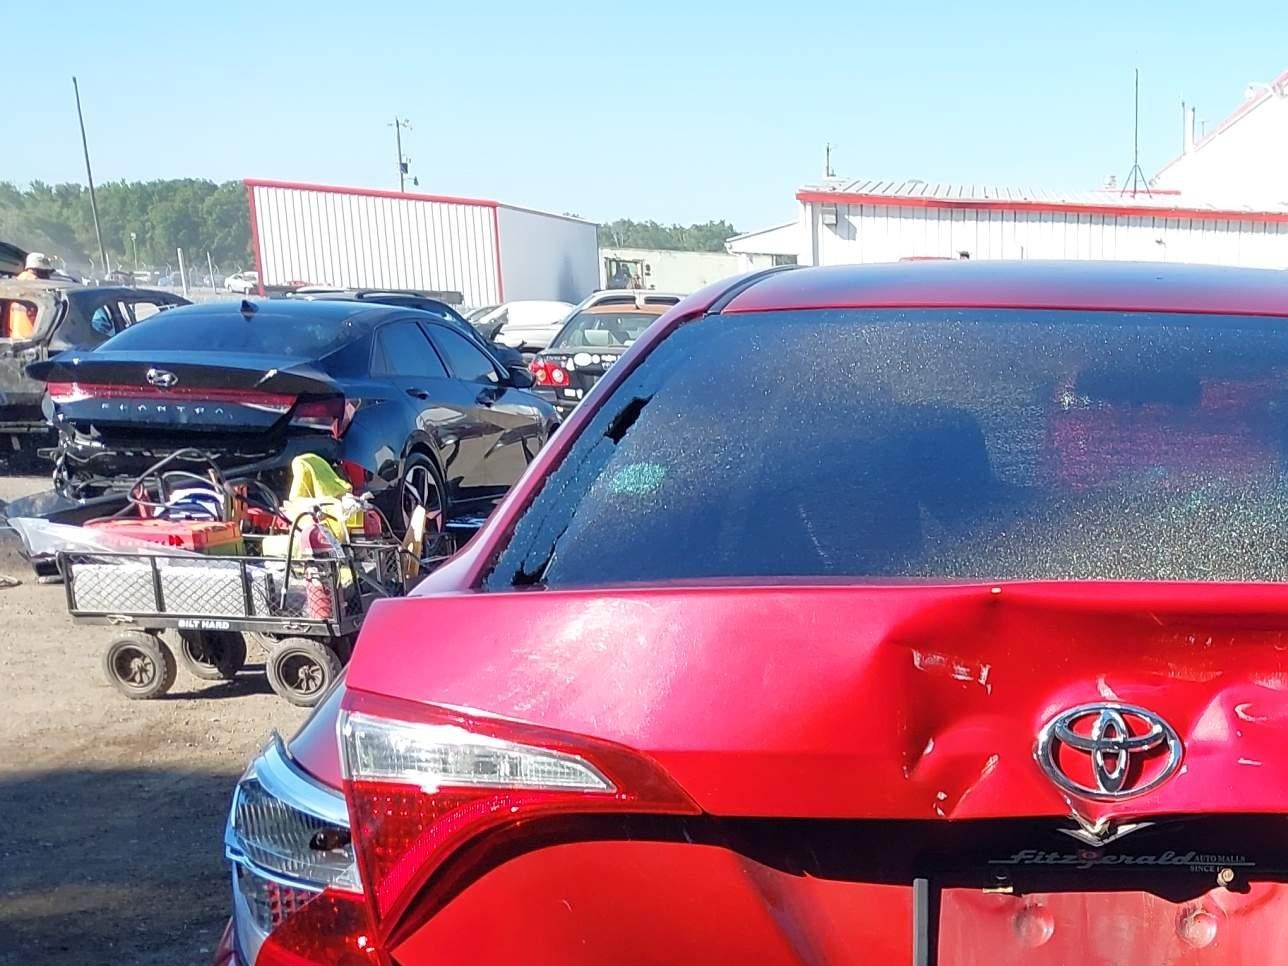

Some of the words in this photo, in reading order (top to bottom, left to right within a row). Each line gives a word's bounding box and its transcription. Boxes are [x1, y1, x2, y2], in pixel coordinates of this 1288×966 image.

[178, 619, 200, 628] BILT
[201, 621, 230, 630] HARD
[1007, 850, 1196, 869] Fitzgerald
